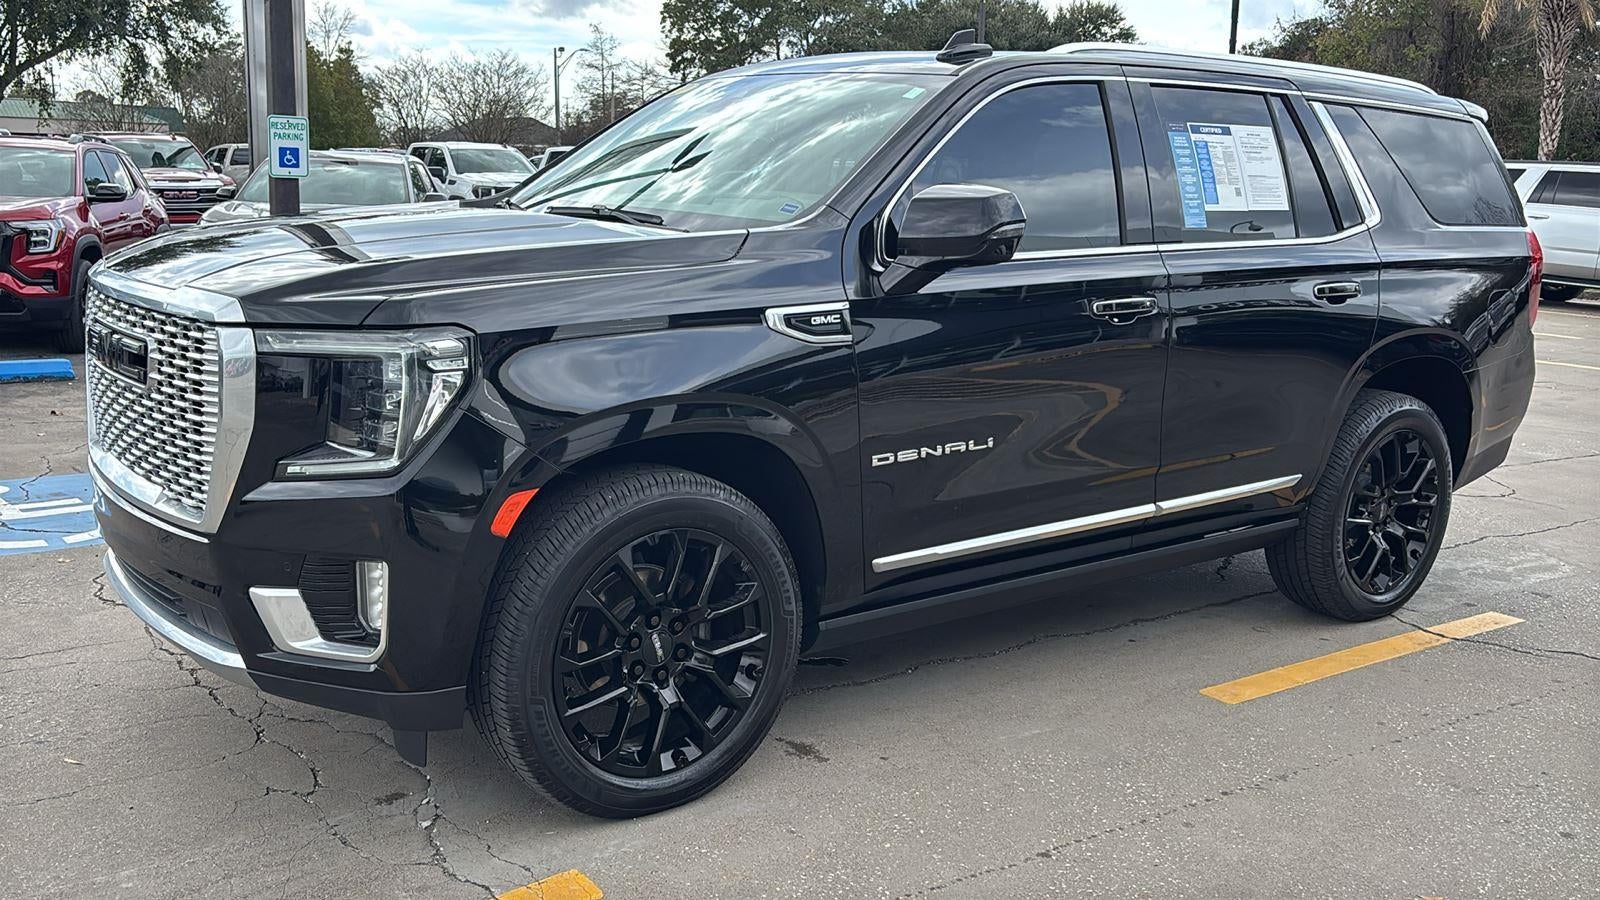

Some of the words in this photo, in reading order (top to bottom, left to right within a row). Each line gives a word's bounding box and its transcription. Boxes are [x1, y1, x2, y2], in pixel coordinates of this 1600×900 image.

[271, 122, 306, 131] RESERVED
[273, 132, 304, 141] PARKING
[163, 191, 198, 199] GMC
[811, 314, 841, 325] GMC
[871, 437, 994, 467] DENALI
